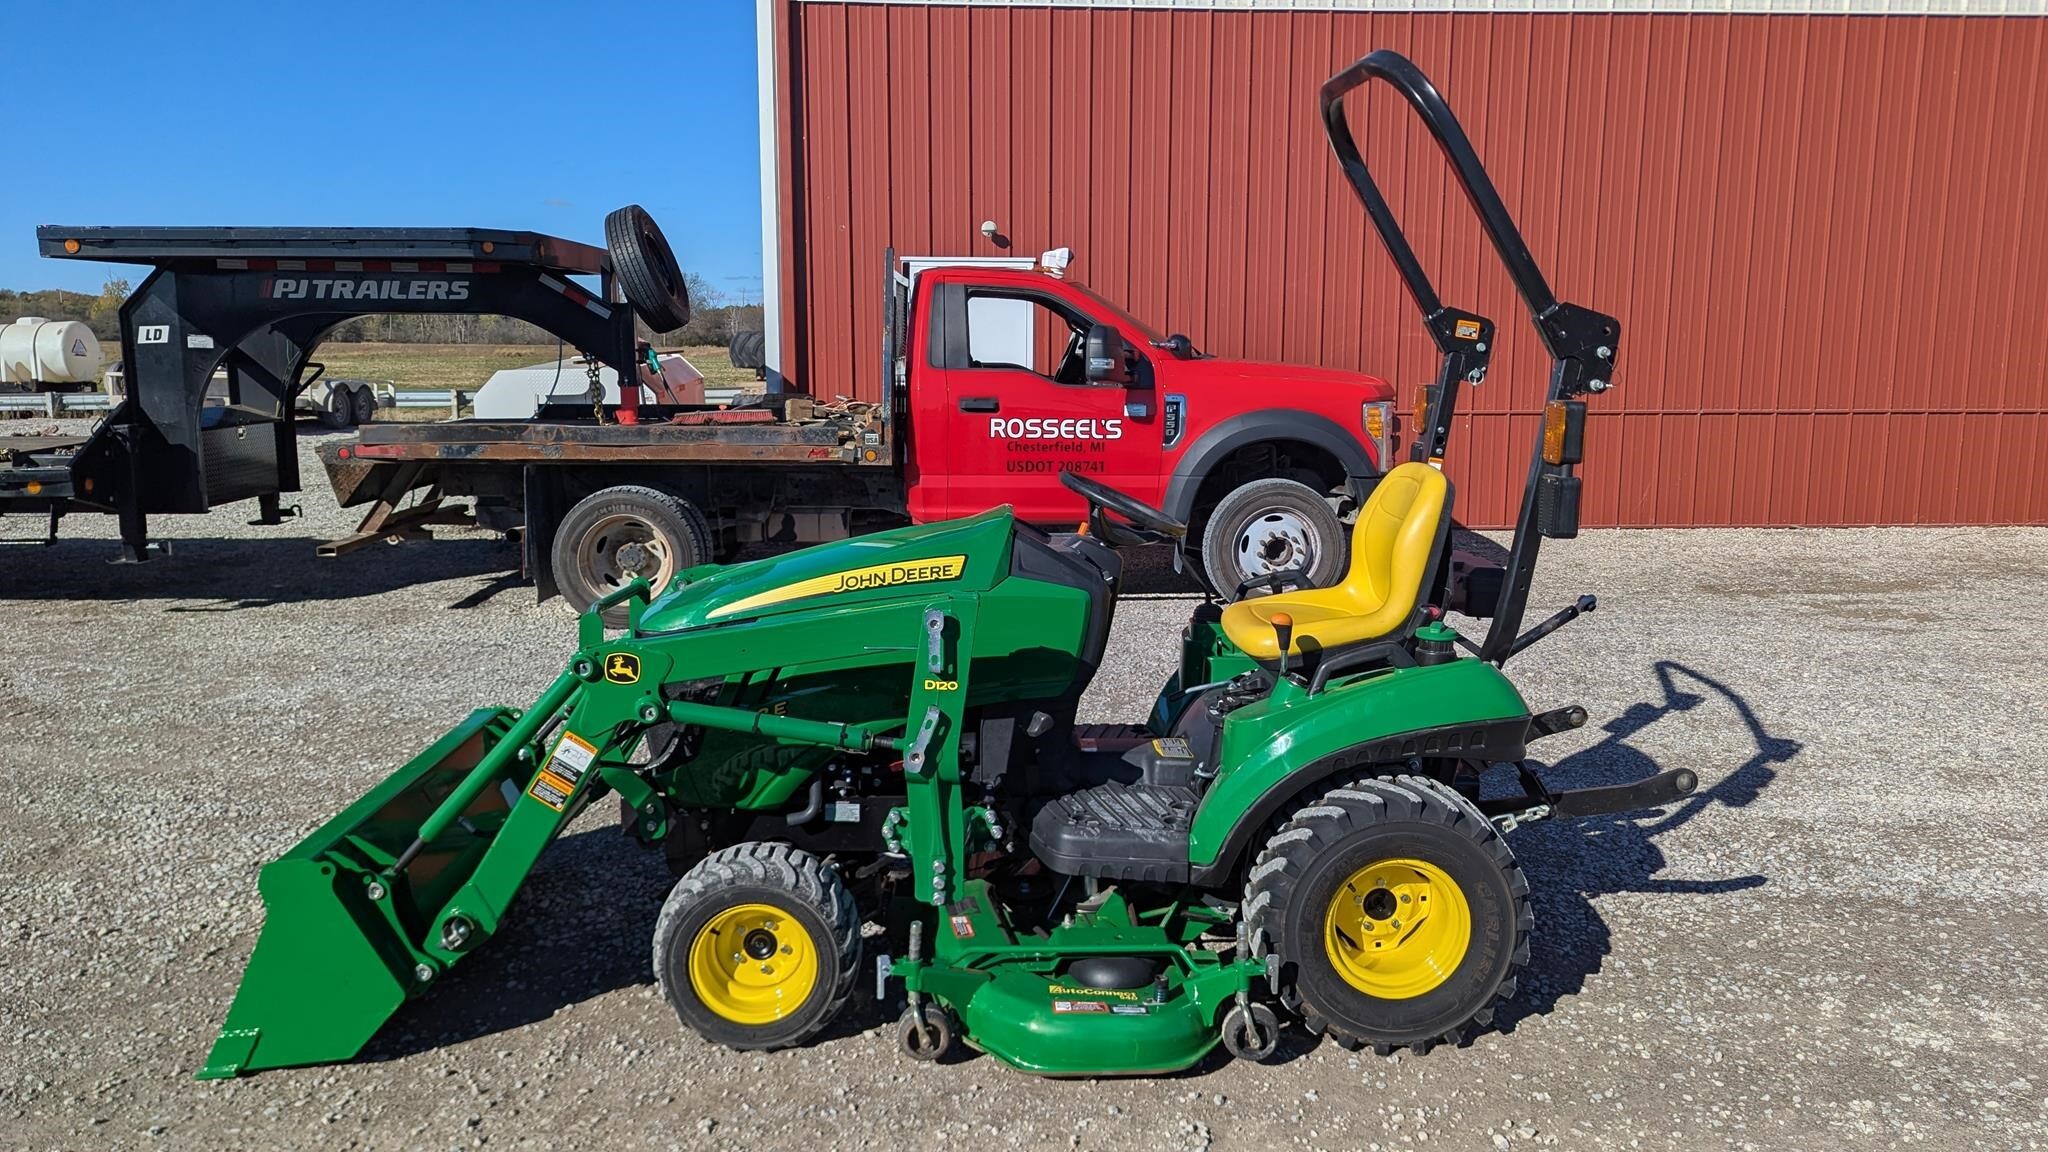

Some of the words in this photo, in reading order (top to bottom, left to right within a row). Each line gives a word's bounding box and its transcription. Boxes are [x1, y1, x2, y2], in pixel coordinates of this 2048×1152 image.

[273, 279, 309, 299] PJ
[312, 279, 470, 300] TRAILERS
[145, 328, 163, 341] LD
[988, 417, 1123, 439] ROSSEEL'S
[1007, 441, 1086, 453] Chesterfield,
[1090, 441, 1105, 452] MI
[1007, 460, 1053, 473] USDOT
[1059, 460, 1105, 473] 208741
[833, 571, 887, 592] JOHN
[891, 564, 954, 582] DEERE
[924, 679, 958, 691] D120
[1049, 985, 1137, 998] AutoConnect
